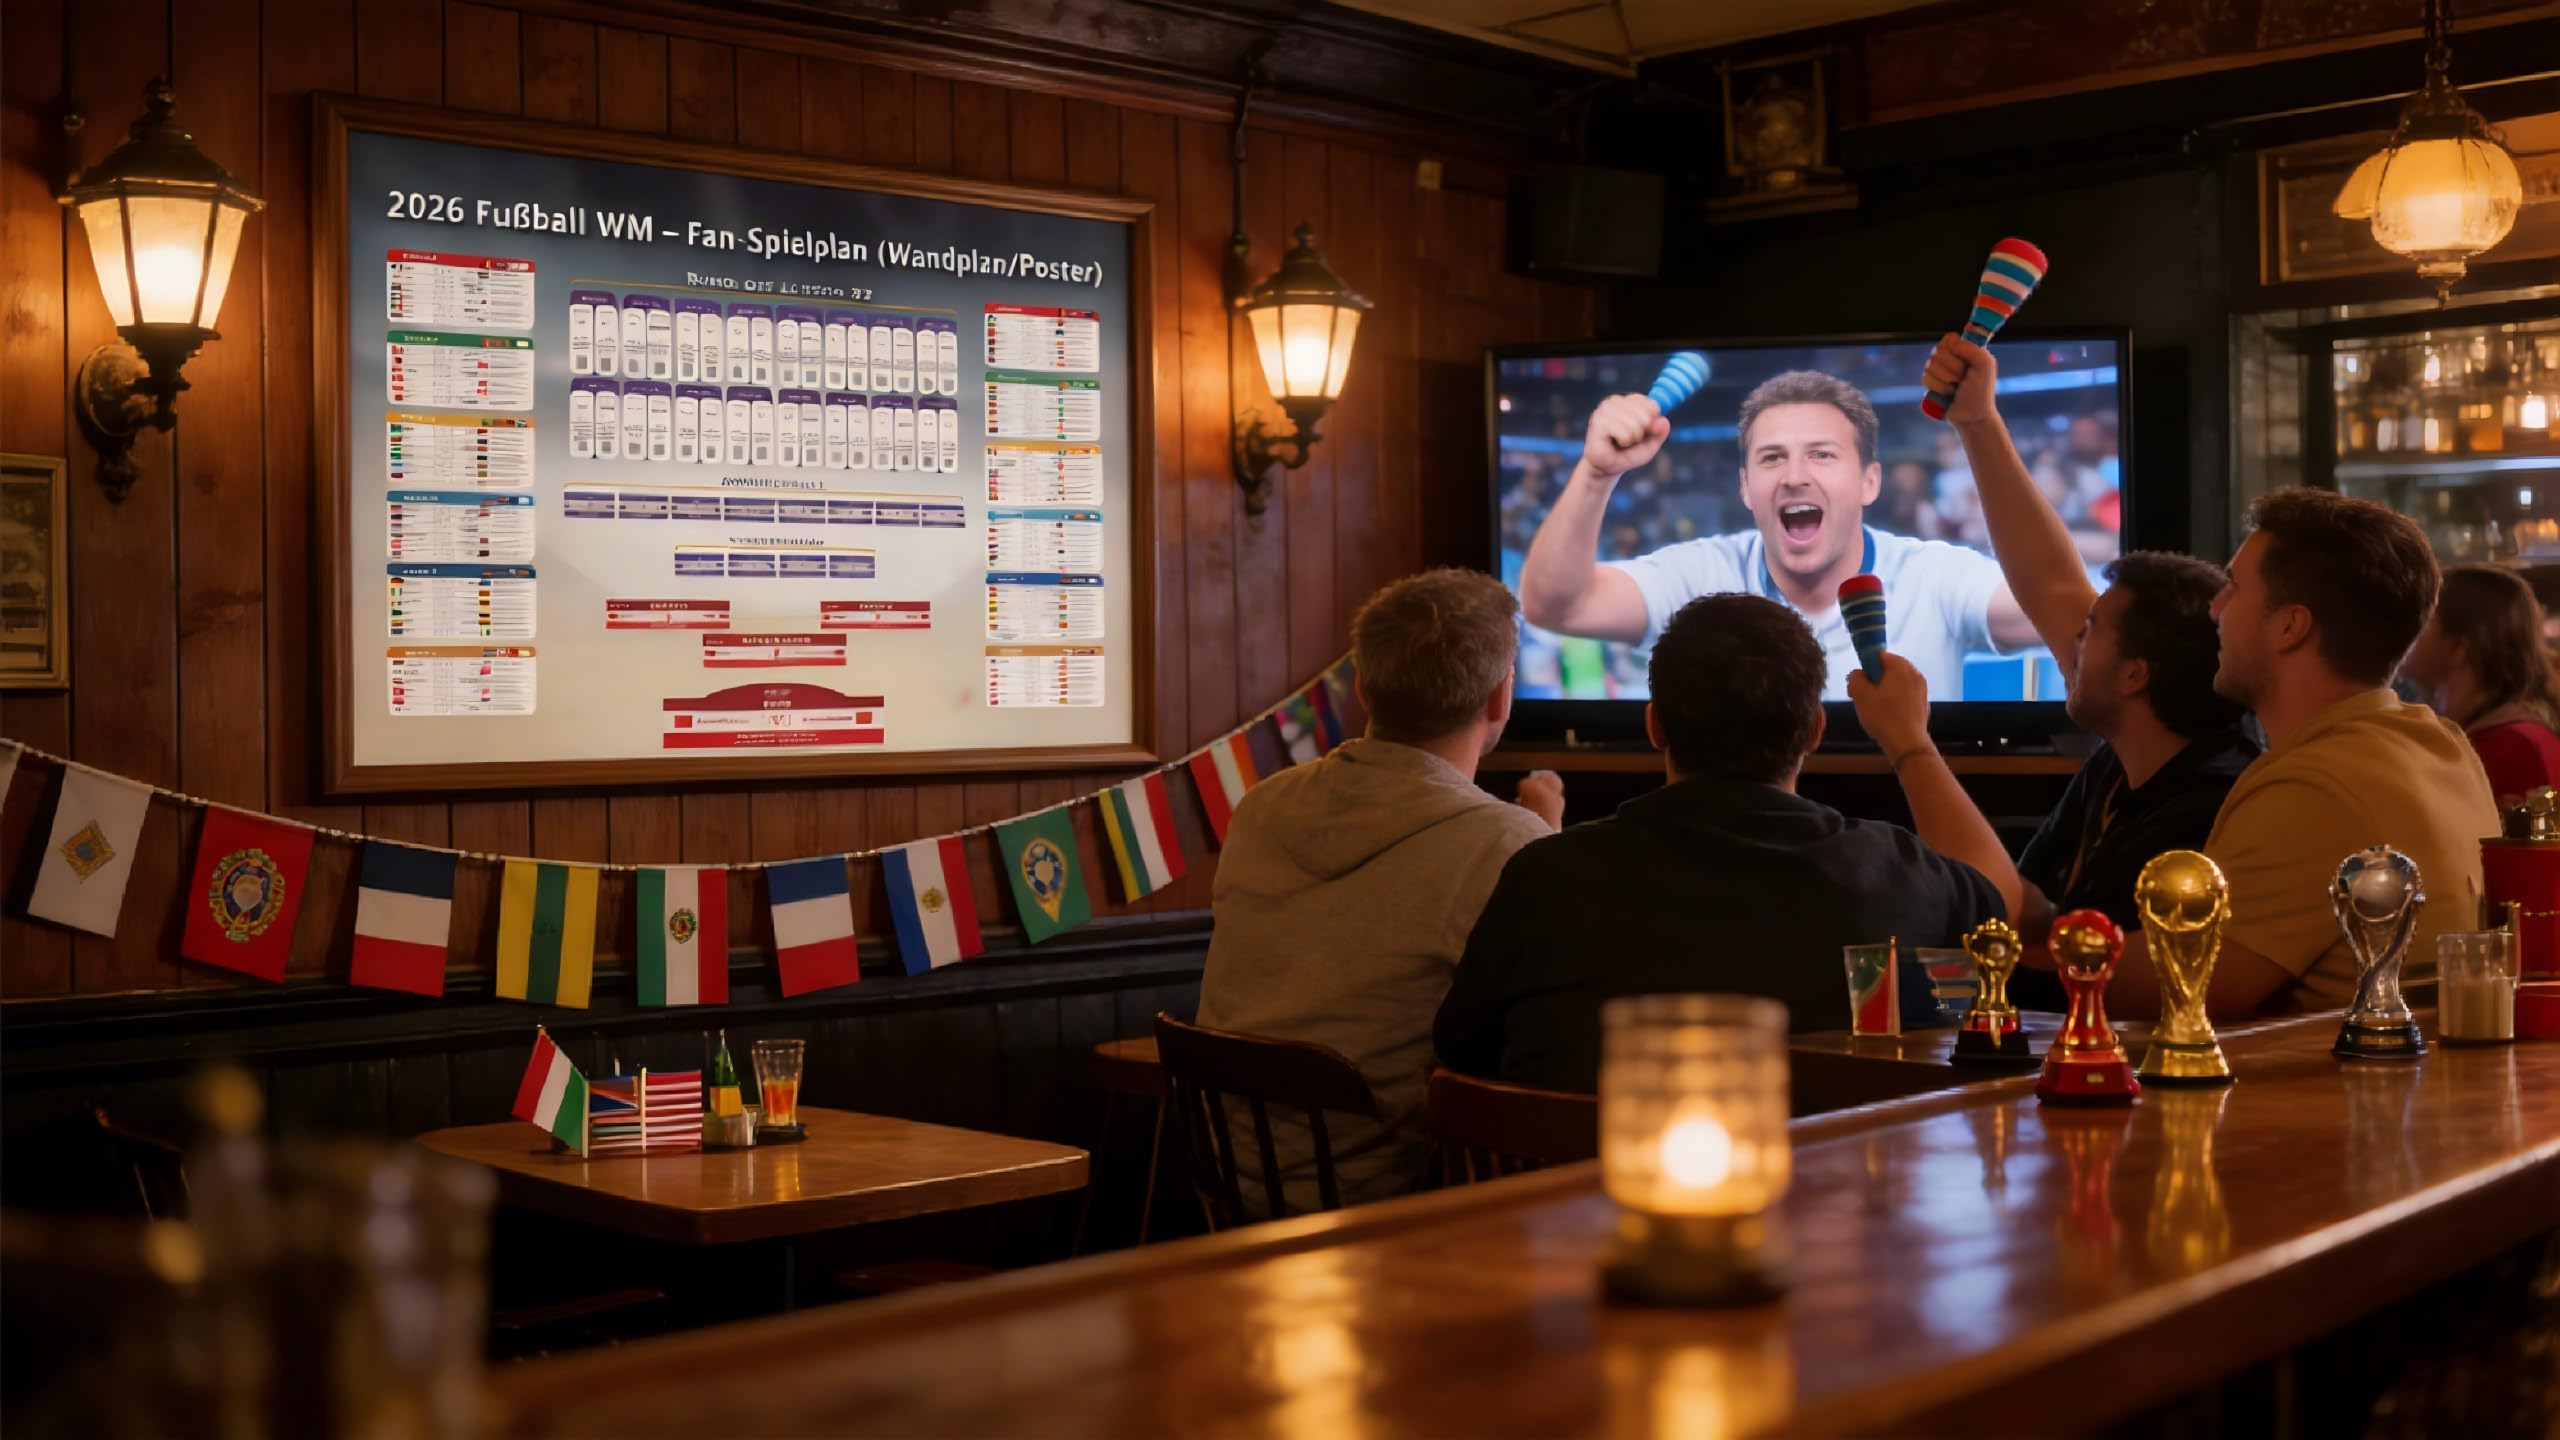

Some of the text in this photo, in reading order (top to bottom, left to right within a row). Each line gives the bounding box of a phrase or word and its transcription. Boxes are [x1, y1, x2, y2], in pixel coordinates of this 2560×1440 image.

[387, 190, 465, 223] 2026
[476, 199, 587, 236] Fußball
[596, 210, 653, 242] WM
[688, 220, 867, 263] Fan-Spielplan
[877, 239, 1103, 289] (Wandplan/Poster)
